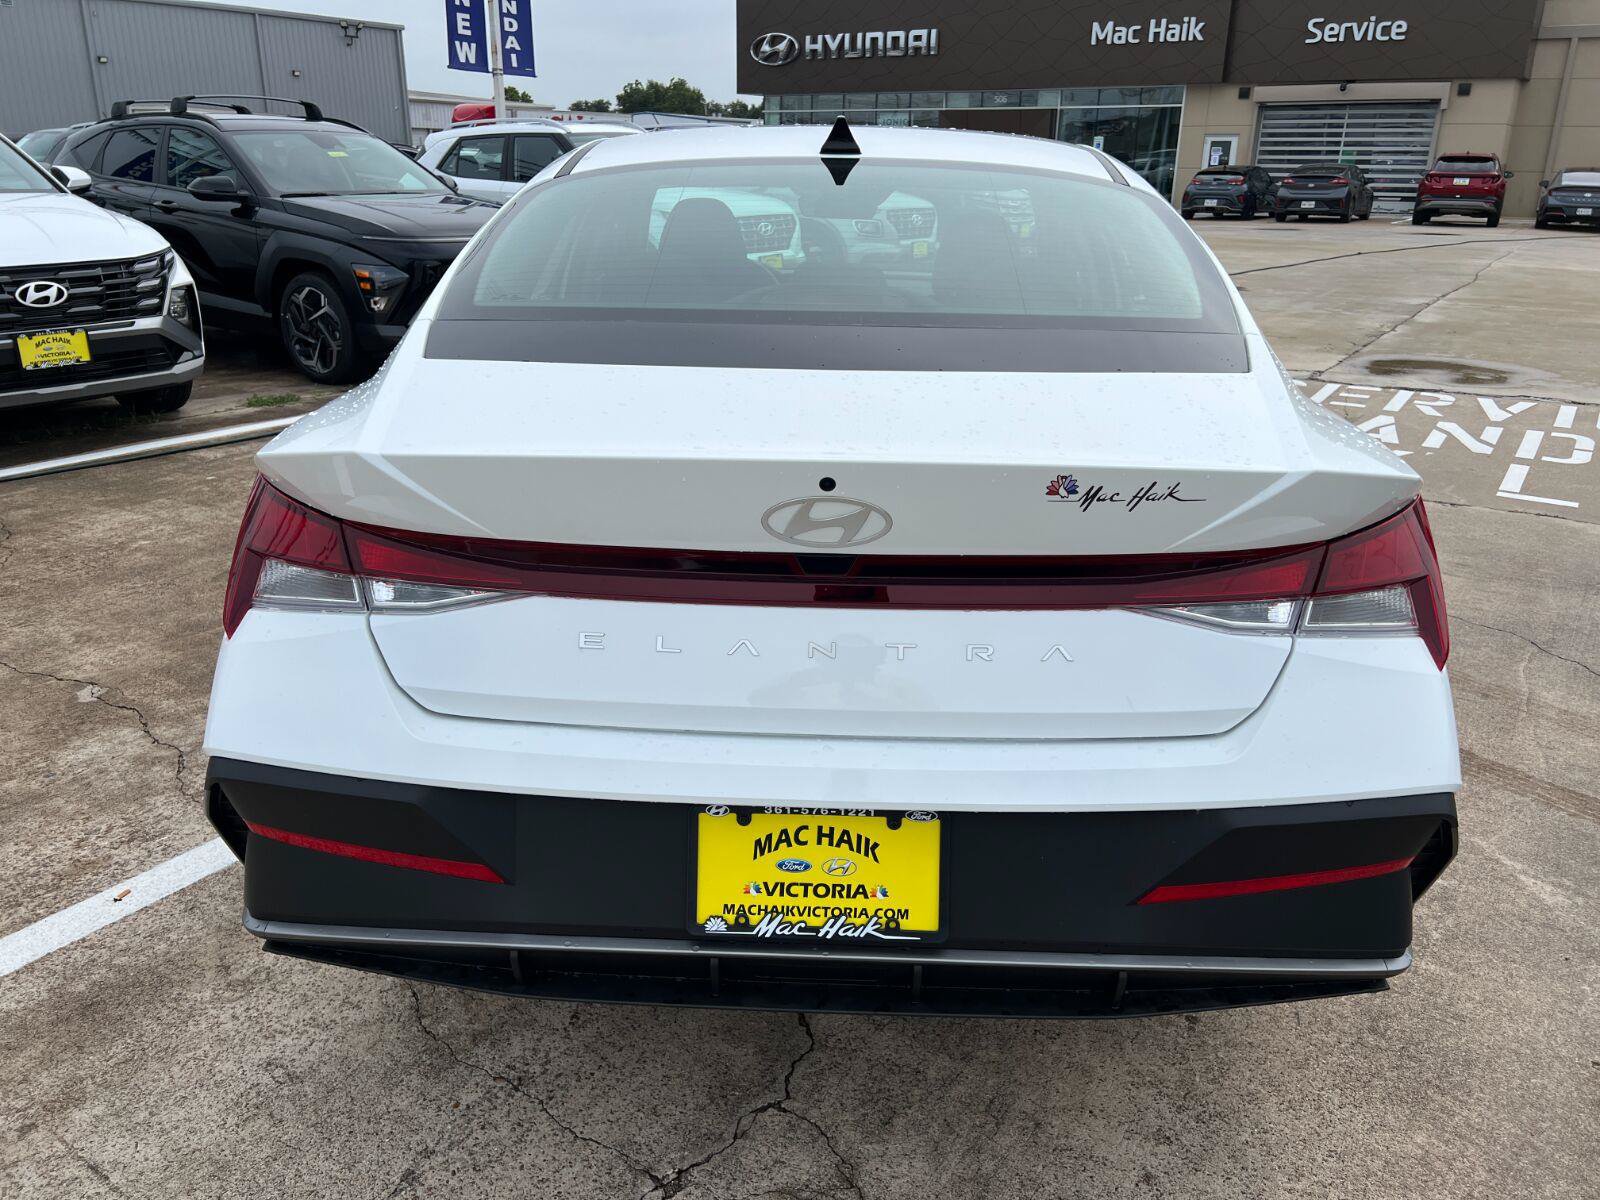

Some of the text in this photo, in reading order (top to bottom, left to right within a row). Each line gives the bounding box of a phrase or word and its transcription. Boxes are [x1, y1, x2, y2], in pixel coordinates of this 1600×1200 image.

[1091, 16, 1206, 46] Mac Haik
[1304, 15, 1408, 44] Service
[805, 28, 939, 60] HYUNDAI
[35, 336, 71, 349] MAC HAIK
[40, 351, 71, 359] VICTORIA
[1079, 481, 1190, 512] Mac Haik
[578, 631, 1074, 663] ELANTRA
[764, 805, 875, 817] 361-576-1221
[752, 825, 881, 864] MAC HAIK
[762, 881, 869, 899] VICTORIA
[722, 903, 909, 920] MACHAIKVICTORIACOM
[752, 913, 890, 940] Mac Haik
